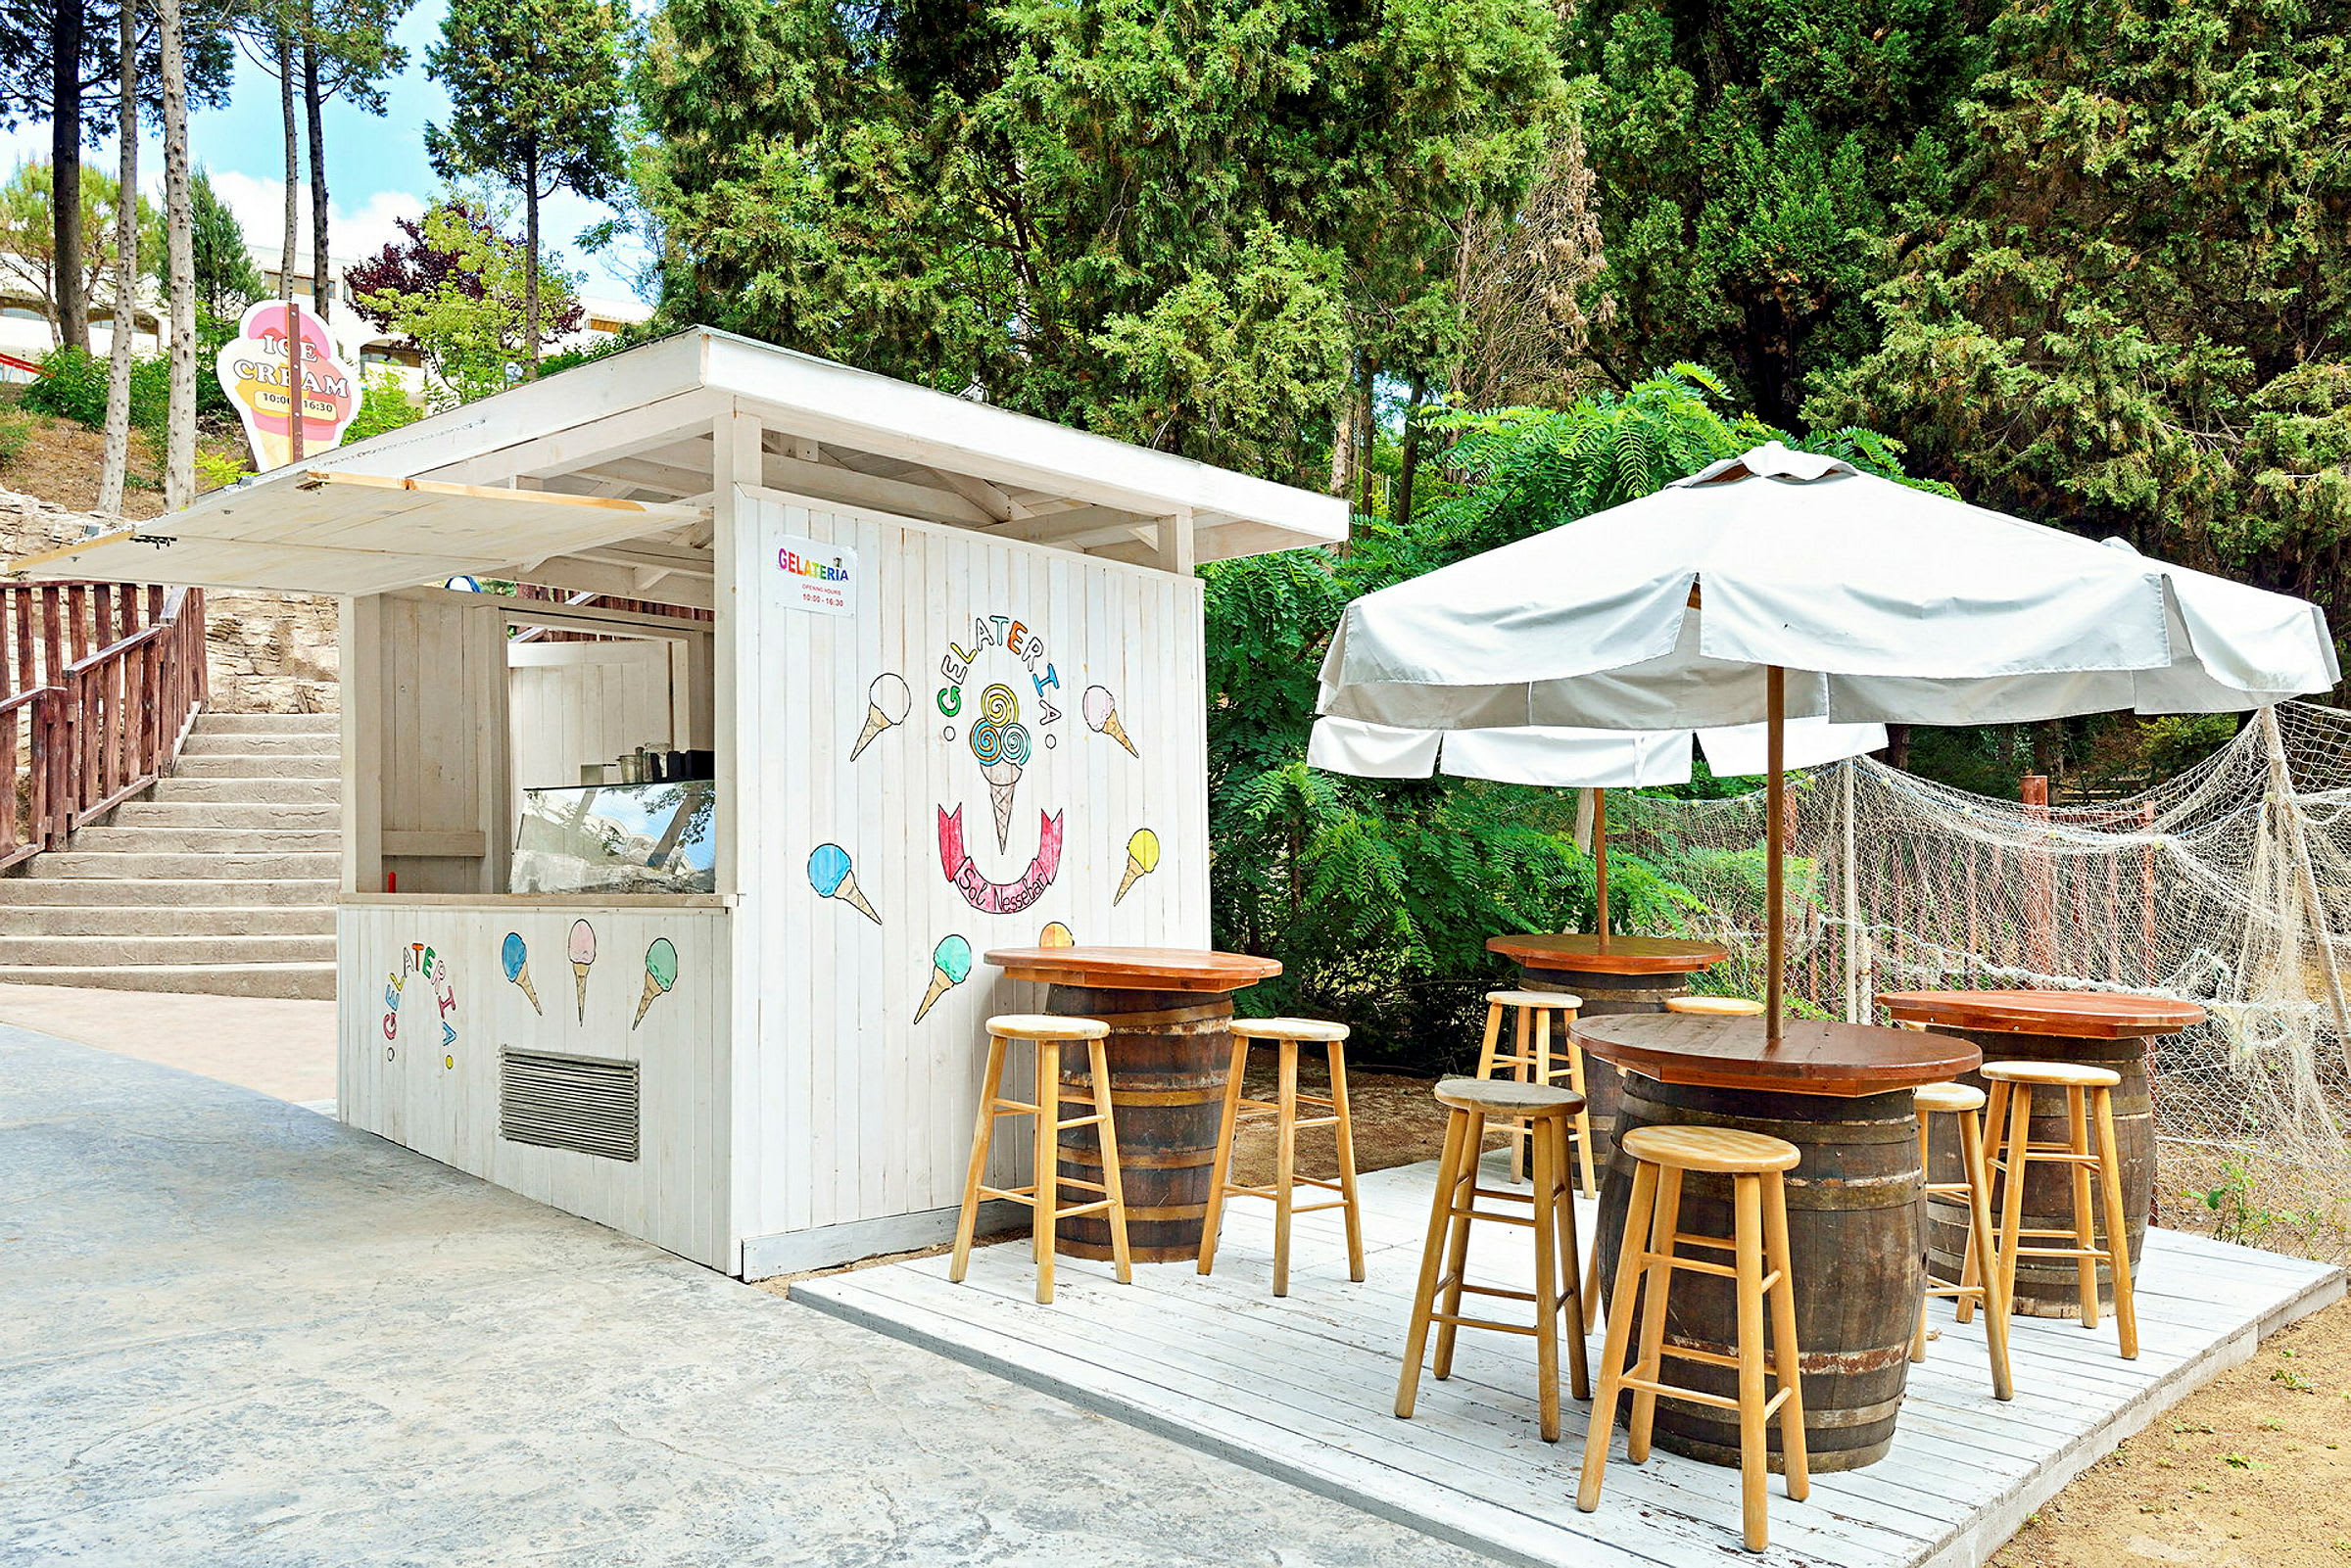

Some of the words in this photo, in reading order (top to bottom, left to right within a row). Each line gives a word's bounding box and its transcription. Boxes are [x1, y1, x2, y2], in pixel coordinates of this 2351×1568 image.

[304, 400, 333, 412] 16:30
[778, 547, 849, 581] GELATERIA
[803, 594, 821, 602] 10:00
[826, 597, 843, 607] 16:30
[937, 615, 1062, 725] GELATERIA
[959, 868, 988, 906] Sol
[994, 873, 1044, 913] Nessebar
[383, 943, 457, 1046] GELATERIA
